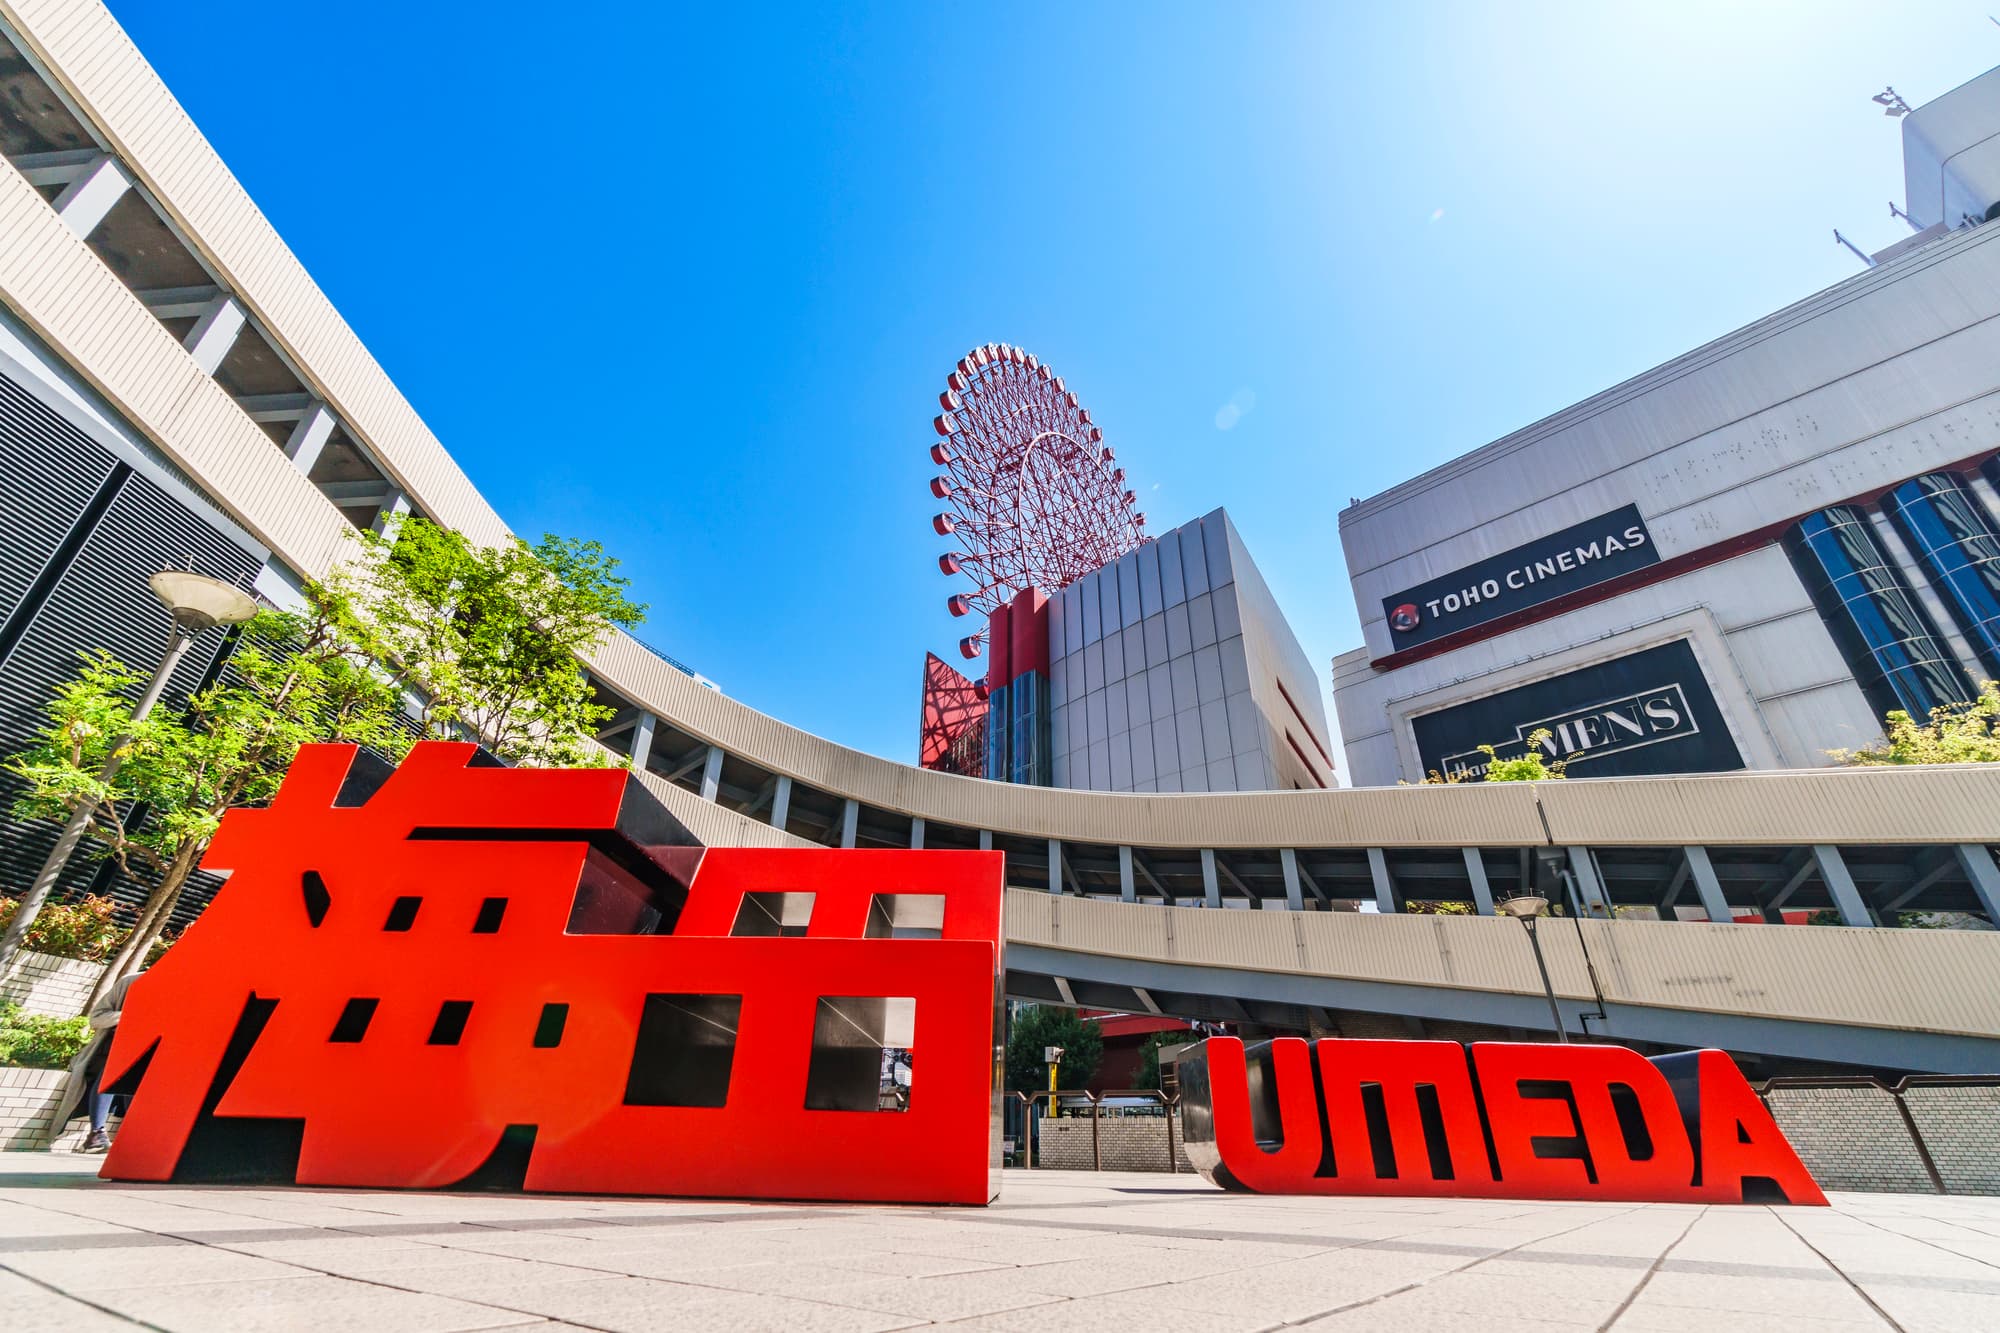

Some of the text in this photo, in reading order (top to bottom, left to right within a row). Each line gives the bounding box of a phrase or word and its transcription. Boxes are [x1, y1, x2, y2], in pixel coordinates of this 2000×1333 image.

[1425, 525, 1646, 618] TOHO CINEMAS
[98, 741, 1005, 1206] 梅田
[1206, 1035, 1831, 1206] UMEDA
